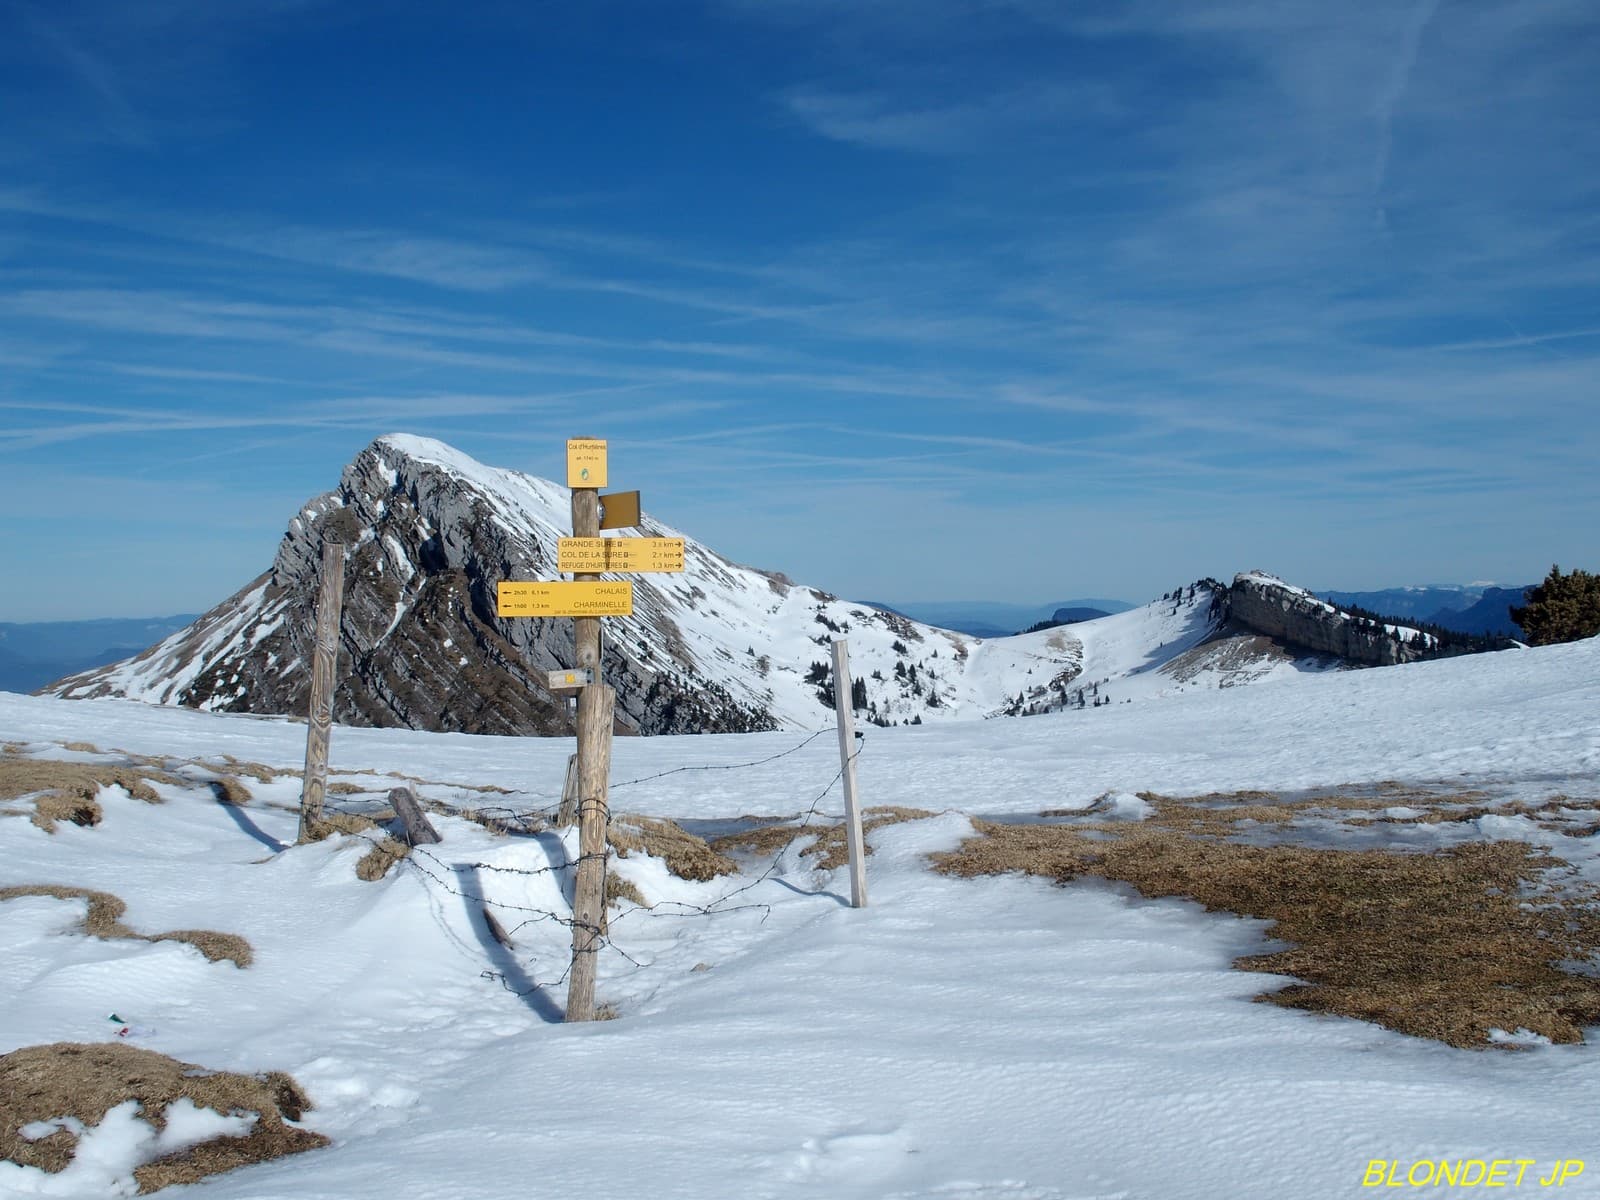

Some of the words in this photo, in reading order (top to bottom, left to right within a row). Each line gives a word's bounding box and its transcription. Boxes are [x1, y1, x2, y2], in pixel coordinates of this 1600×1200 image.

[561, 540, 594, 548] GRANDE
[595, 540, 616, 548] SURE
[663, 540, 674, 548] km
[561, 561, 585, 569] REFUGE
